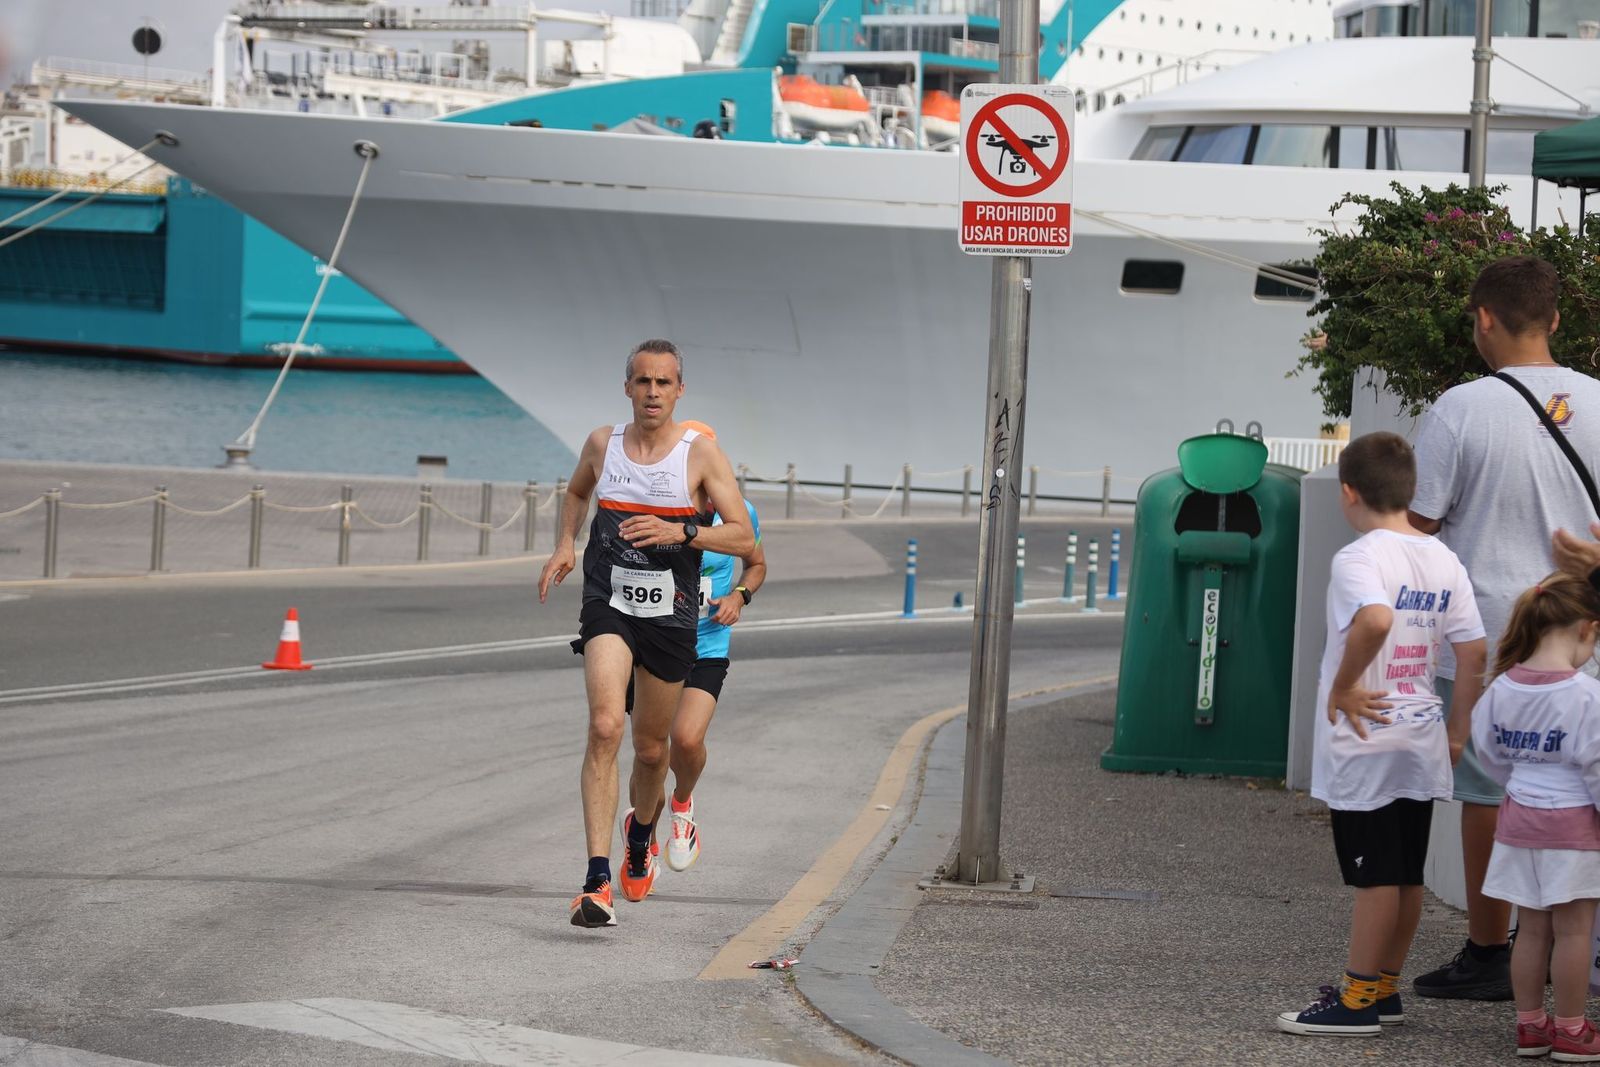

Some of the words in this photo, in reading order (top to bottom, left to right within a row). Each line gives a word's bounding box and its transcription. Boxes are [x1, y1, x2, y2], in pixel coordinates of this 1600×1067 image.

[976, 205, 1056, 222] PROHIBIDO
[964, 226, 1003, 242] USAR
[1008, 227, 1067, 243] DRONES
[622, 585, 663, 604] 596
